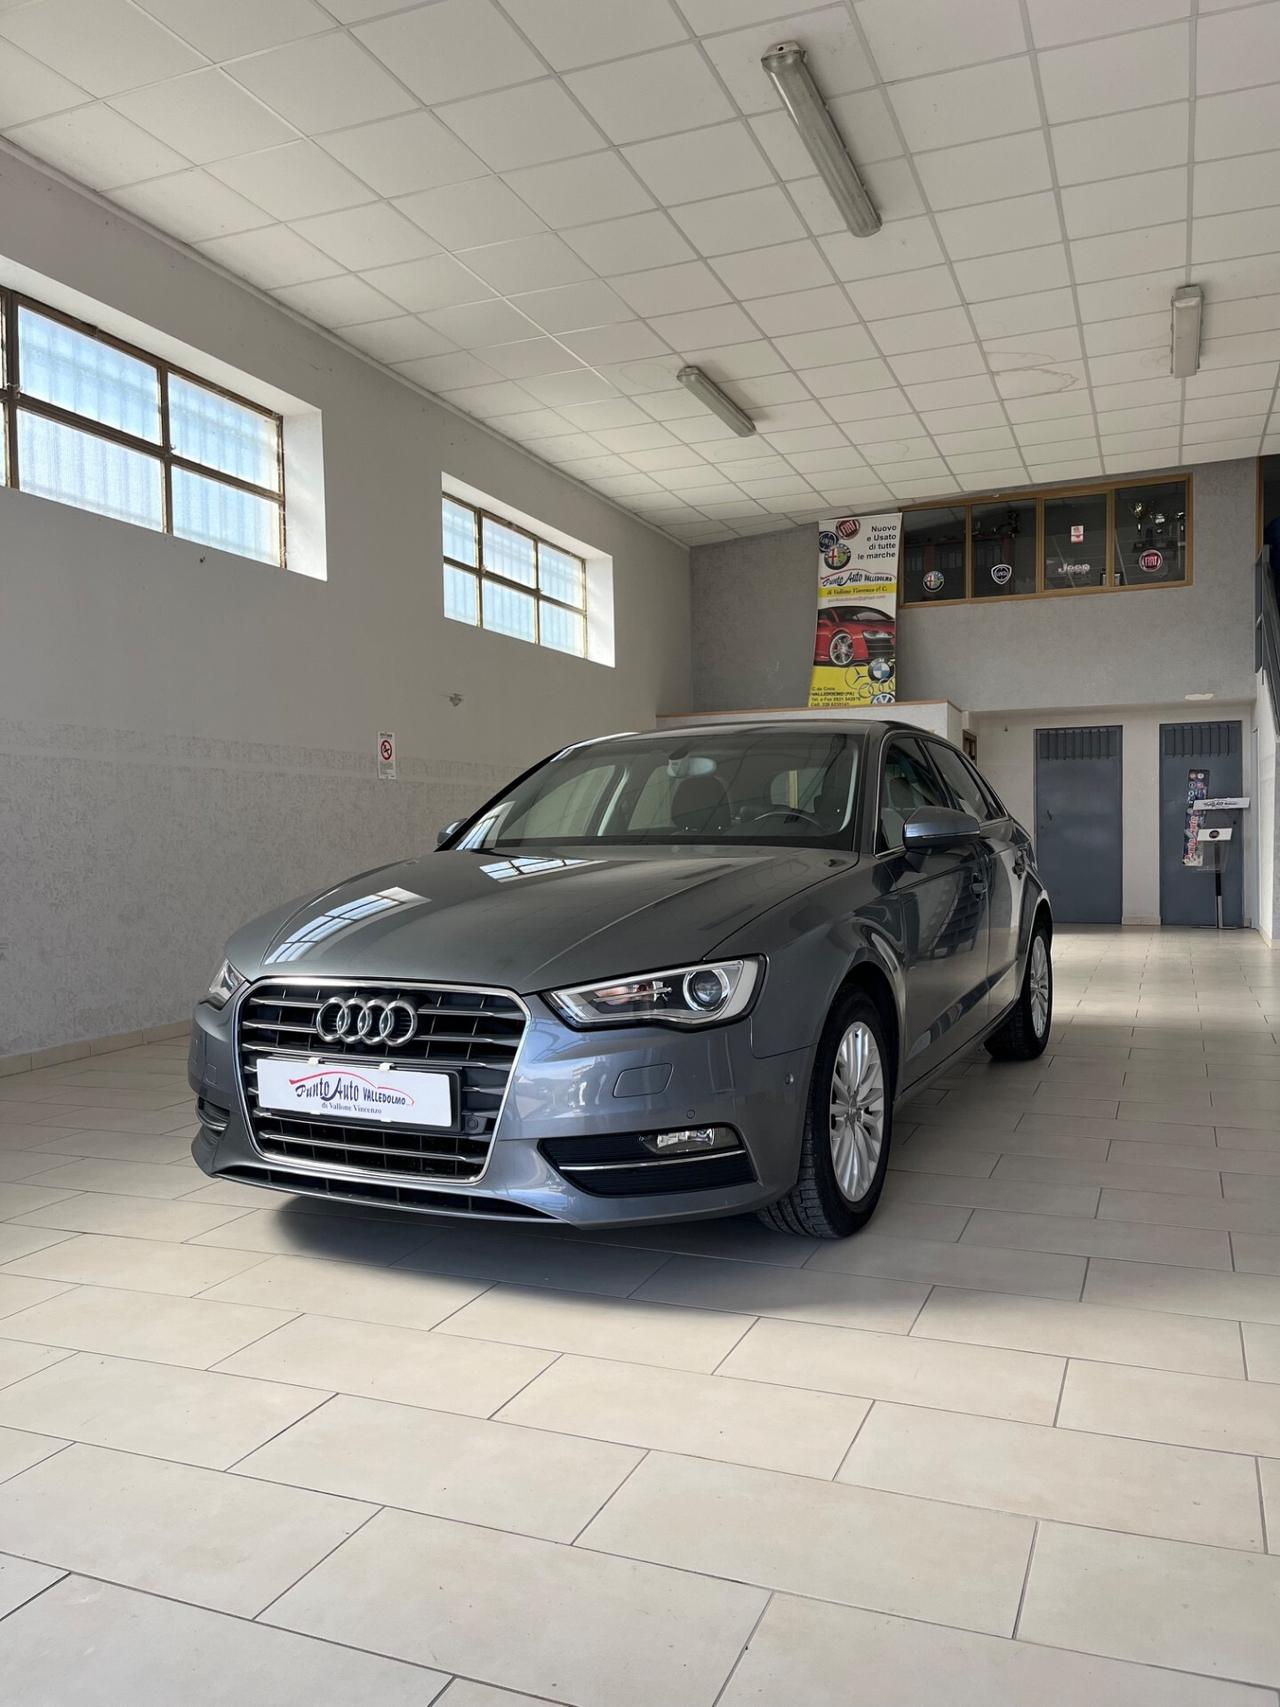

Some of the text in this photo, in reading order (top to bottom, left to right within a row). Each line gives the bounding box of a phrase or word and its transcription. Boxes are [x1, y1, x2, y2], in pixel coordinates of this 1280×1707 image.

[871, 525, 897, 533] Nuovo
[866, 551, 896, 560] marche
[1145, 556, 1158, 567] FIAT
[1061, 563, 1090, 574] Jeep
[837, 572, 862, 586] Auto
[295, 1077, 406, 1105] Punto Auto VALLEDOLMO
[329, 1102, 352, 1112] Vallone
[353, 1105, 382, 1114] Vincenzo
